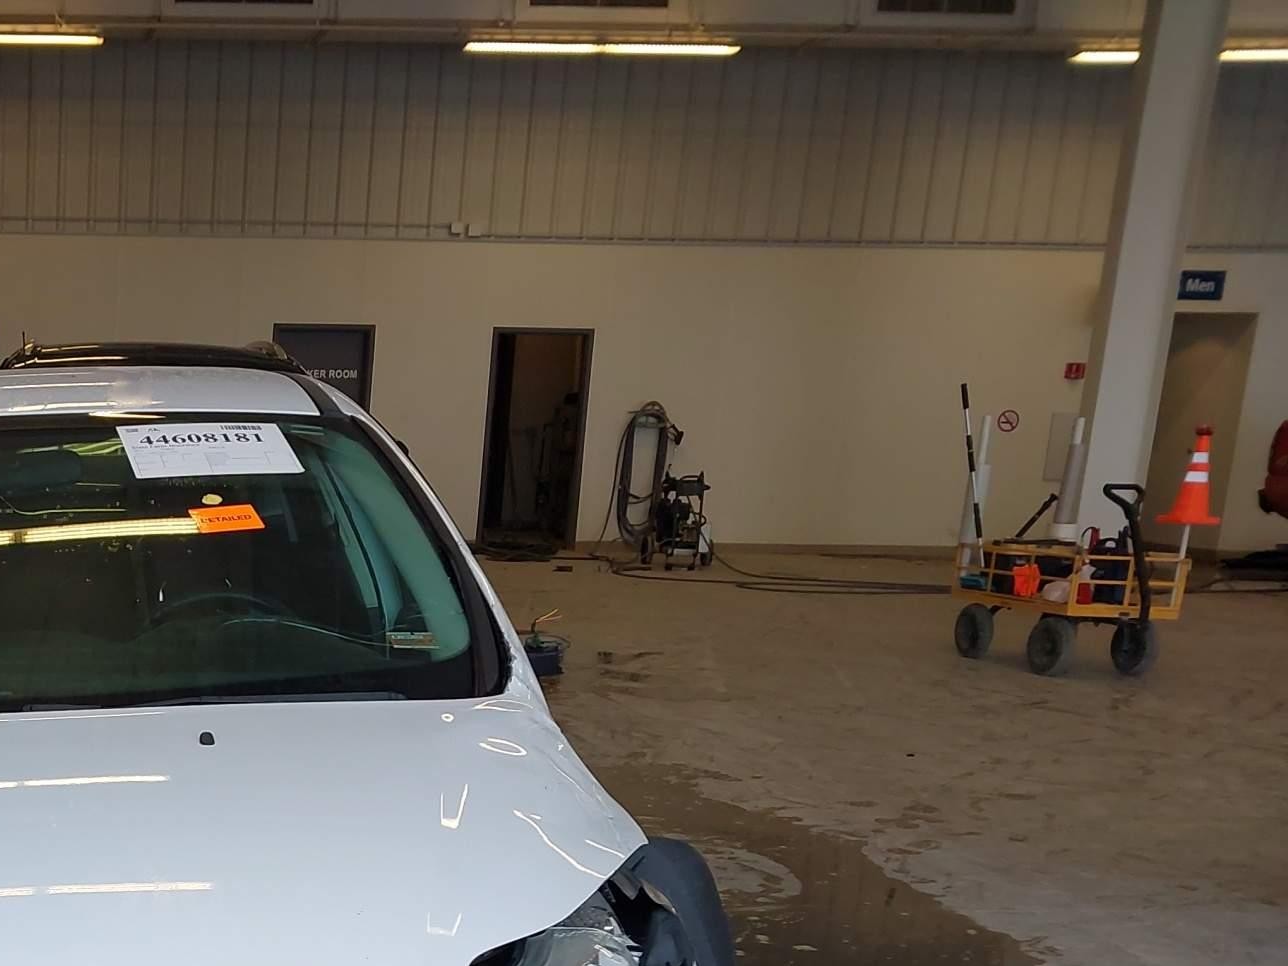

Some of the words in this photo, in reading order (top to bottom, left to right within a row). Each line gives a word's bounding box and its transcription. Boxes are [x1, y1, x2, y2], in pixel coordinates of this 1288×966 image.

[1186, 278, 1215, 292] Men
[329, 369, 358, 379] ROOM
[139, 432, 265, 445] 44608181
